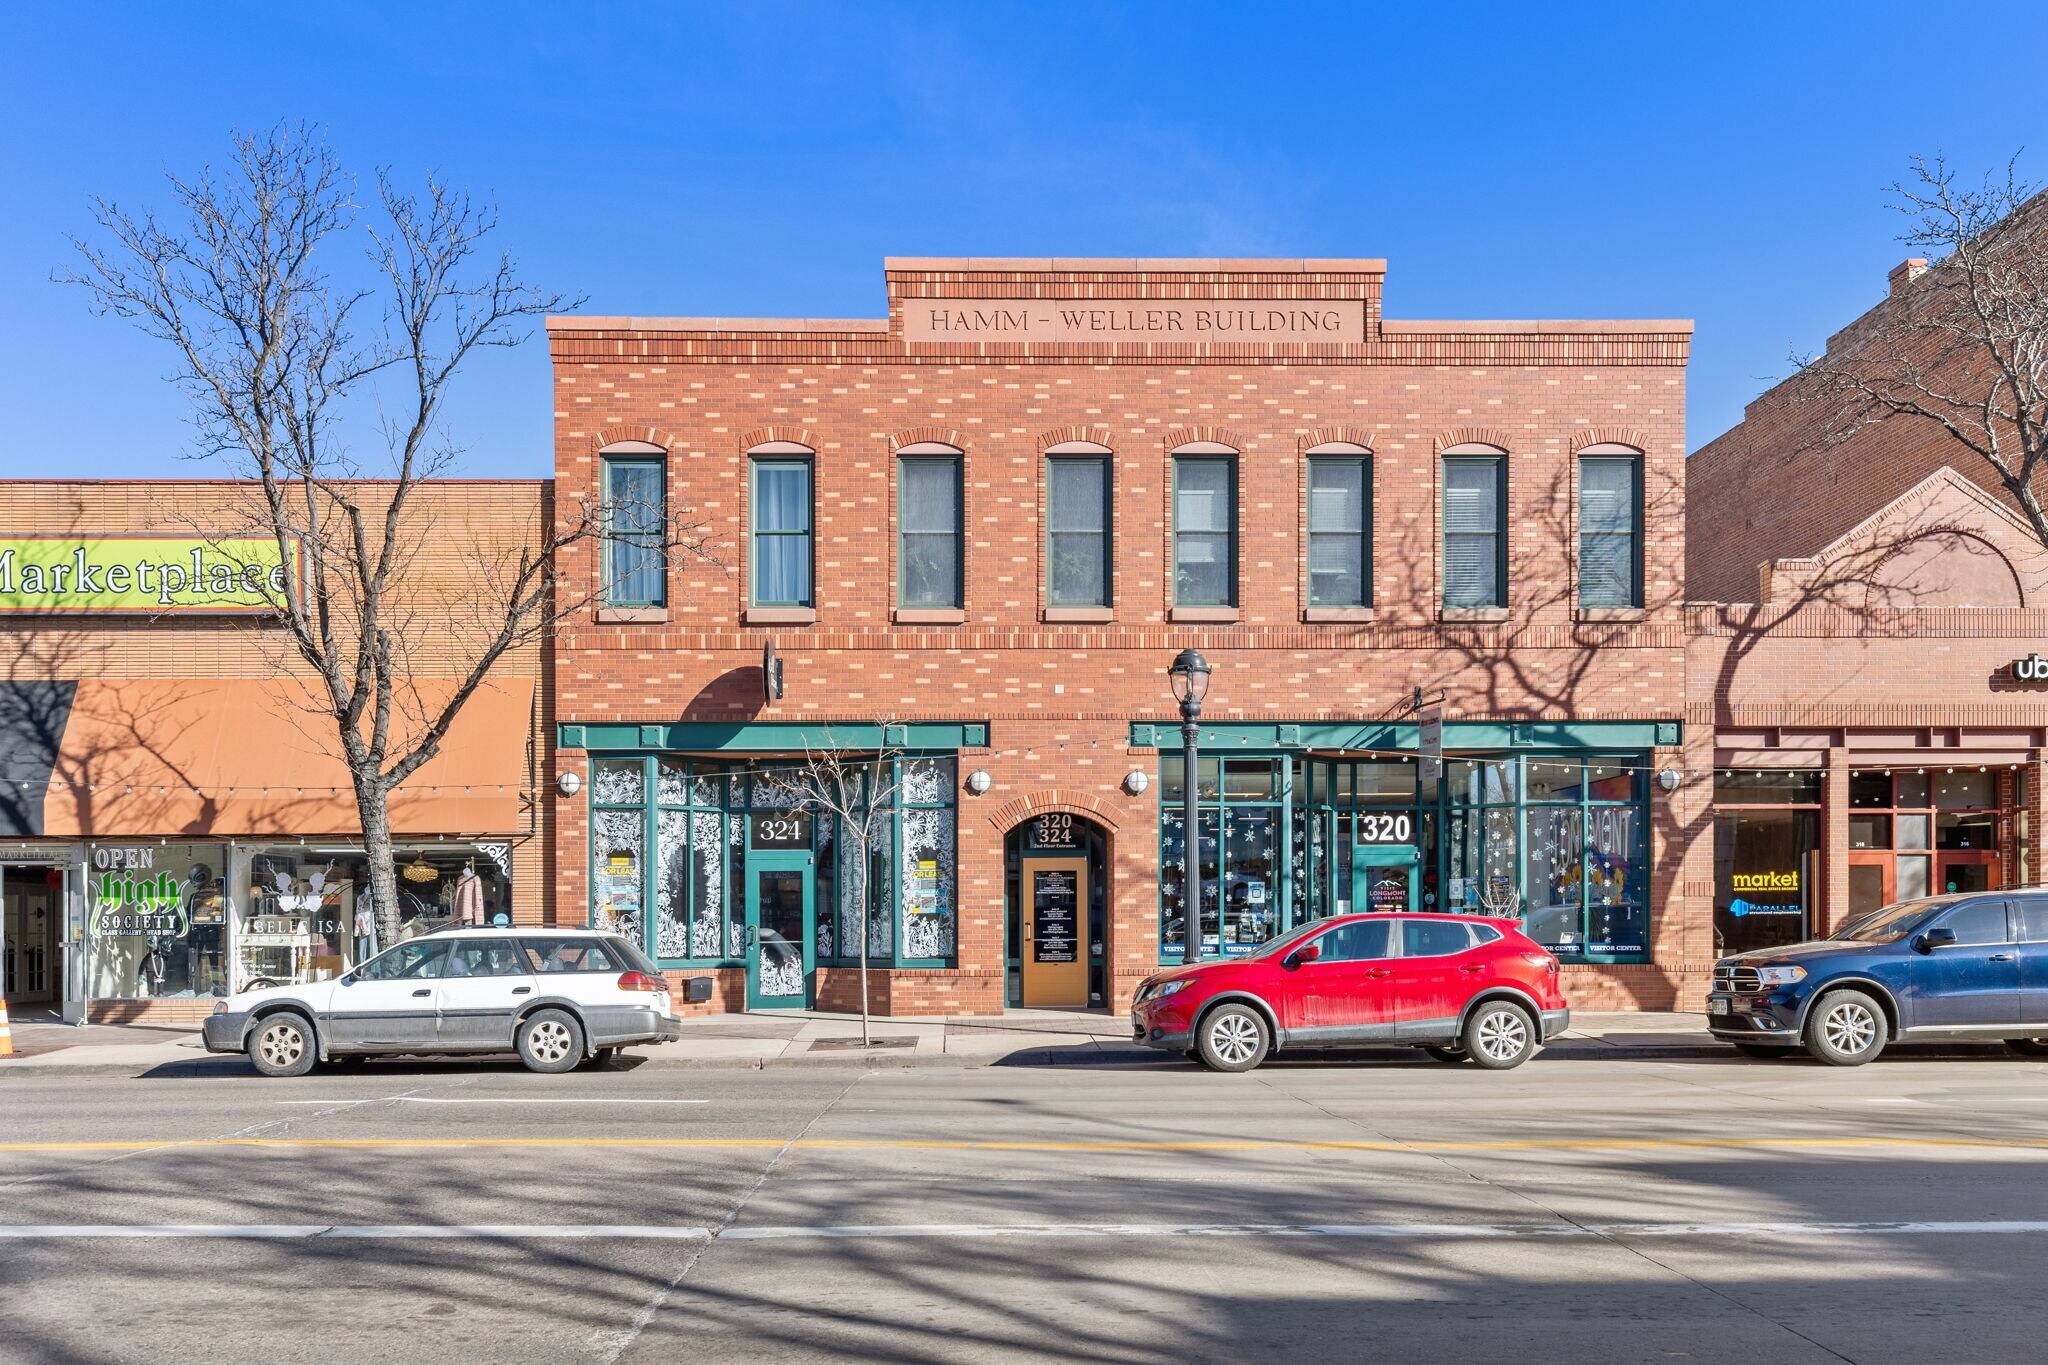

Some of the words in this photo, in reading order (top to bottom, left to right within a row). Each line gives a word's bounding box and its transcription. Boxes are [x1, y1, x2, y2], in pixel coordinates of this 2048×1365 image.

[930, 310, 1029, 331] HAMM
[1059, 310, 1185, 331] WELLER
[1194, 310, 1341, 331] BUILDING
[1040, 814, 1072, 828] 320
[1363, 815, 1410, 841] 320
[760, 820, 802, 840] 324
[1039, 829, 1072, 843] 324
[95, 848, 154, 869] OPEN
[617, 867, 635, 875] LEAS
[1733, 871, 1798, 887] market
[100, 869, 179, 915] high
[101, 915, 177, 929] SOCIETY
[318, 920, 347, 933] ISA
